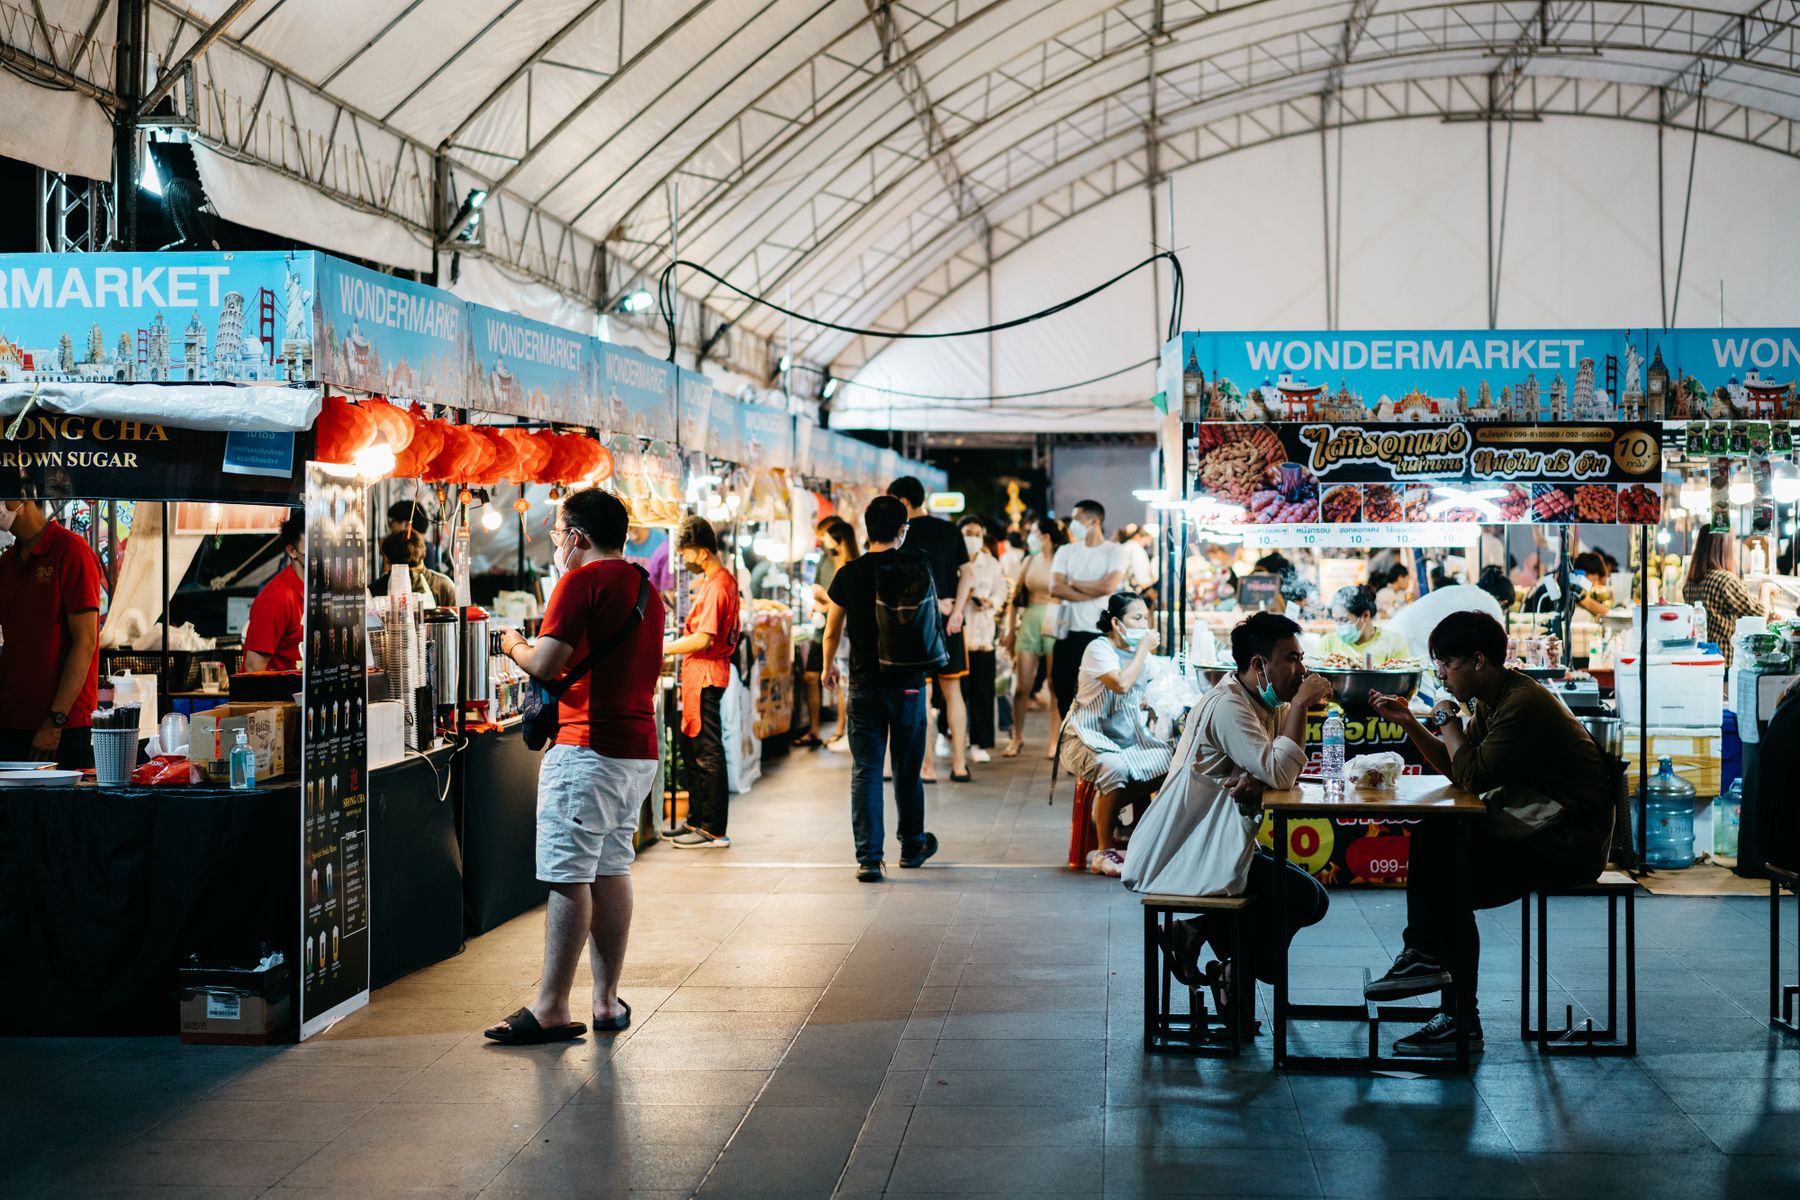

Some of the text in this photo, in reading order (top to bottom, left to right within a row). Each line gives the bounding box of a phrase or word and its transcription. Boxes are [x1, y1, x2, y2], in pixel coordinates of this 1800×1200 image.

[0, 267, 230, 308] MARKET
[487, 318, 582, 372] WONDERMARKET
[1245, 339, 1584, 370] WONDERMARKET
[605, 353, 668, 394] WONDERMARKET
[0, 417, 169, 441] ONG CHA
[0, 451, 138, 469] ROWN SUGAR
[1303, 535, 1323, 544] 10.-
[1350, 535, 1370, 544] 10.-
[1370, 859, 1409, 873] 099-
